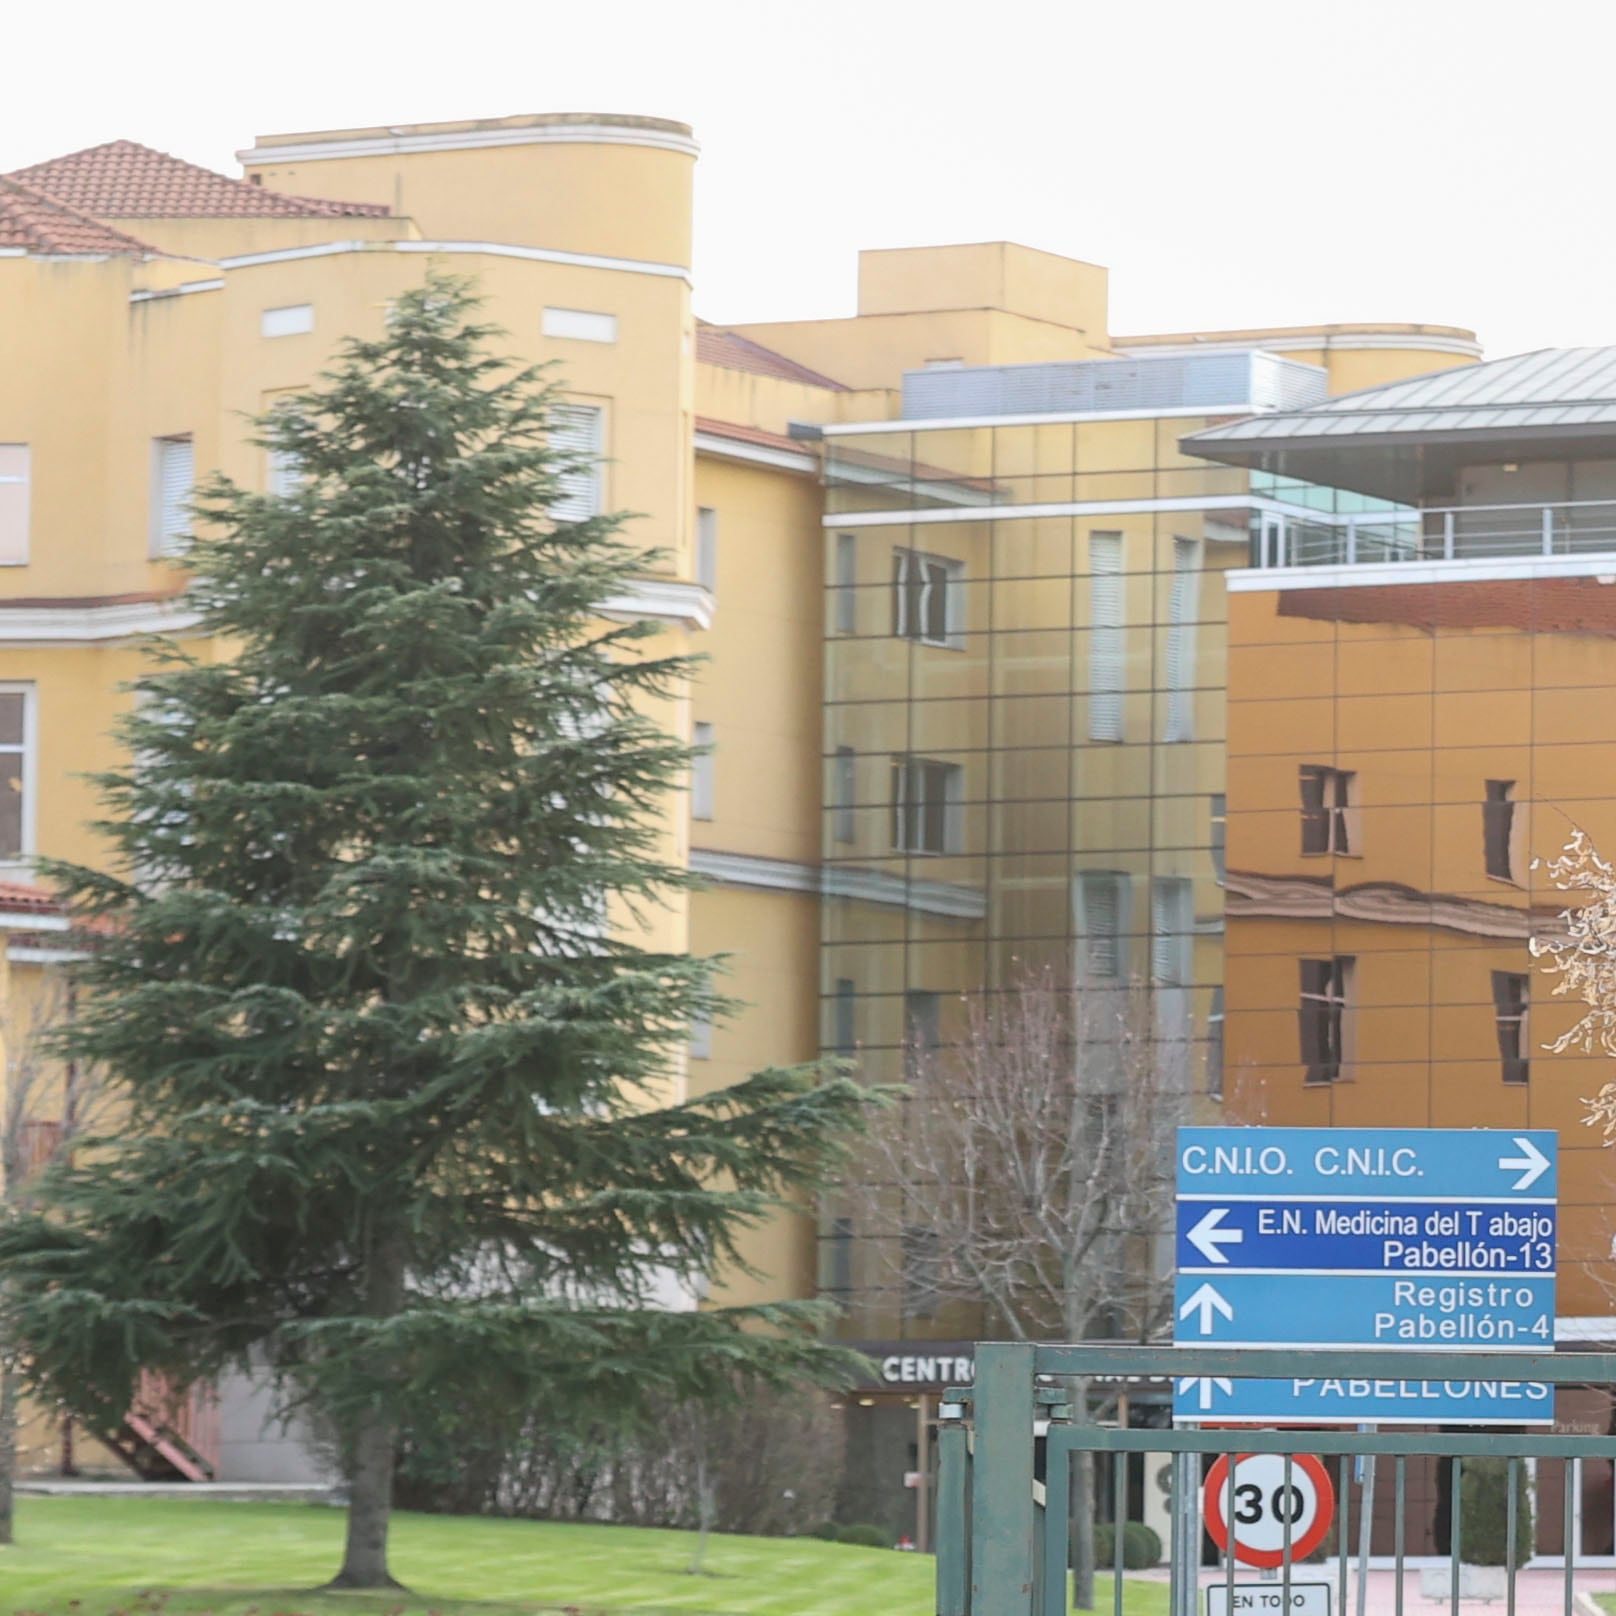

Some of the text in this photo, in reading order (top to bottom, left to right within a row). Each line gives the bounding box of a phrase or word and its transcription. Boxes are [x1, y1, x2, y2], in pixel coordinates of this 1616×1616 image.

[1182, 1145, 1424, 1177] C.N.I.O. C.N.I.C.
[1258, 1209, 1307, 1235] E.N.
[1315, 1210, 1417, 1237] Medicina
[1424, 1210, 1460, 1237] del
[1383, 1240, 1553, 1269] Pabellón-13
[1394, 1281, 1534, 1312] Registro
[1374, 1312, 1551, 1340] Pabellón-4
[882, 1356, 974, 1382] CENTR
[1234, 1484, 1305, 1524] 30
[1232, 1594, 1305, 1608] EN TOO
